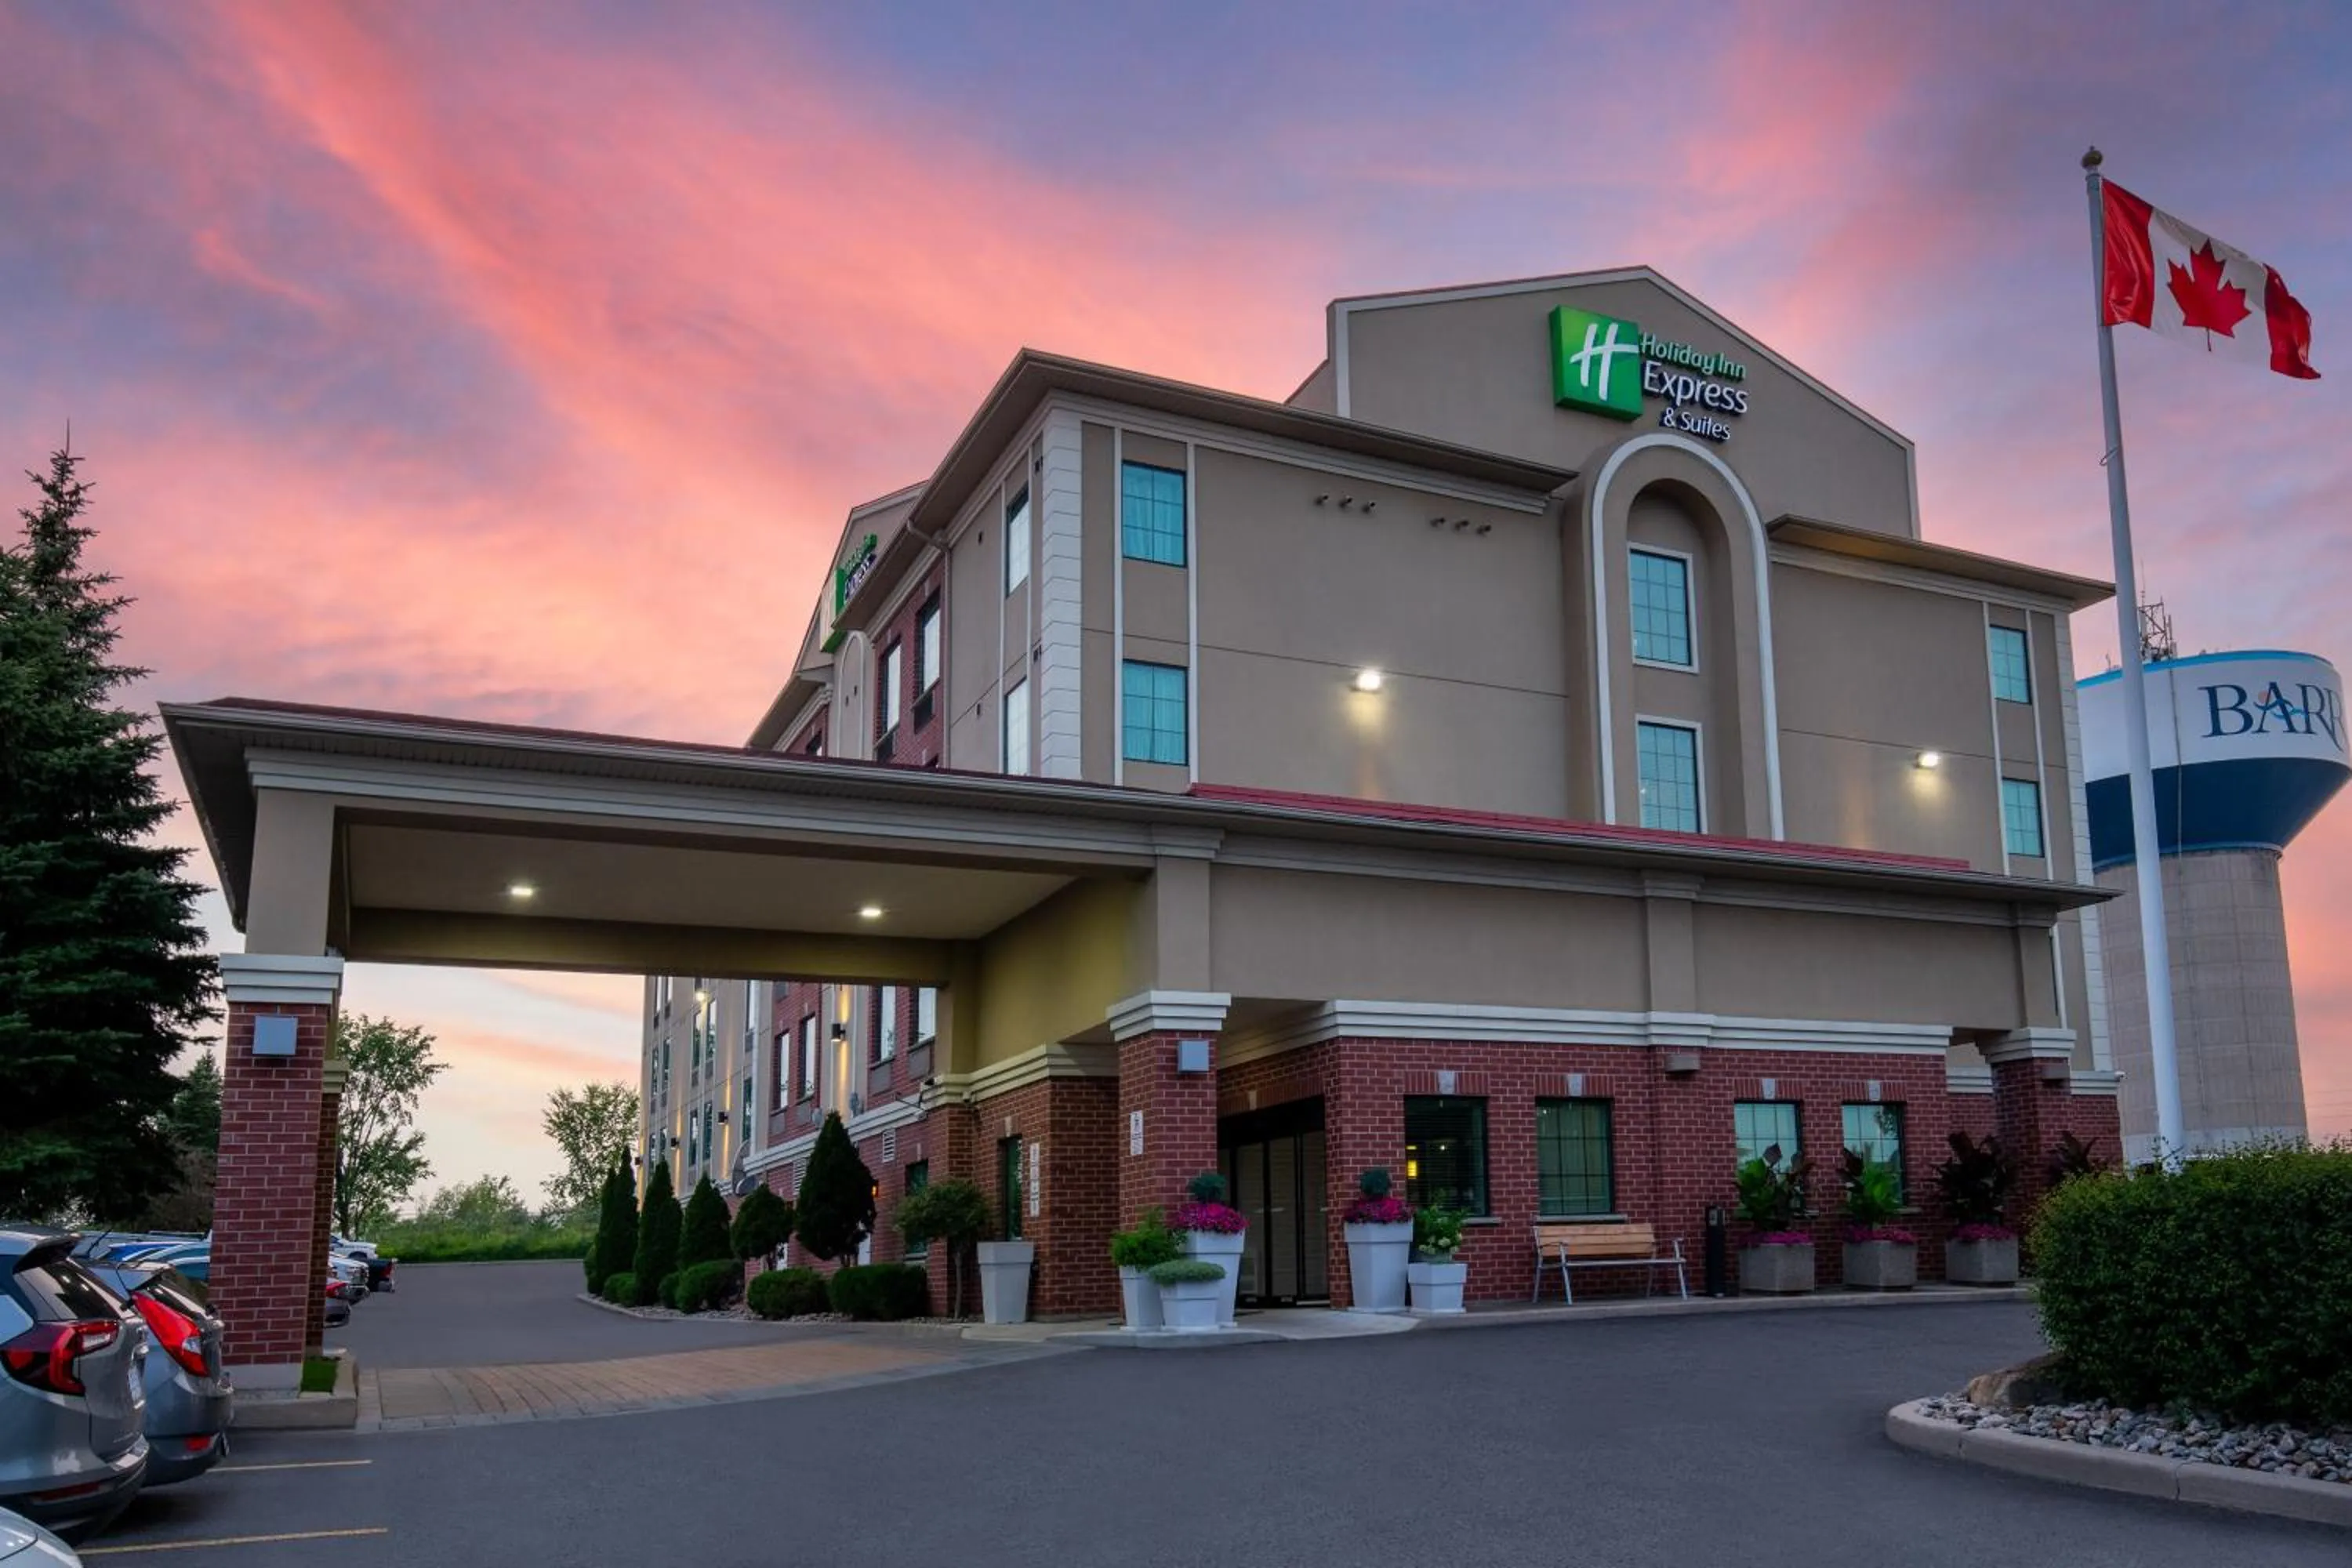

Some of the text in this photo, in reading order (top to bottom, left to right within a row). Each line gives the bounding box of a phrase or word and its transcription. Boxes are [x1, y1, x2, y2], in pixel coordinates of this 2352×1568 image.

[1640, 331, 1747, 379] Holiday Inn
[1643, 359, 1750, 414] Express
[1663, 407, 1731, 441] & Suites
